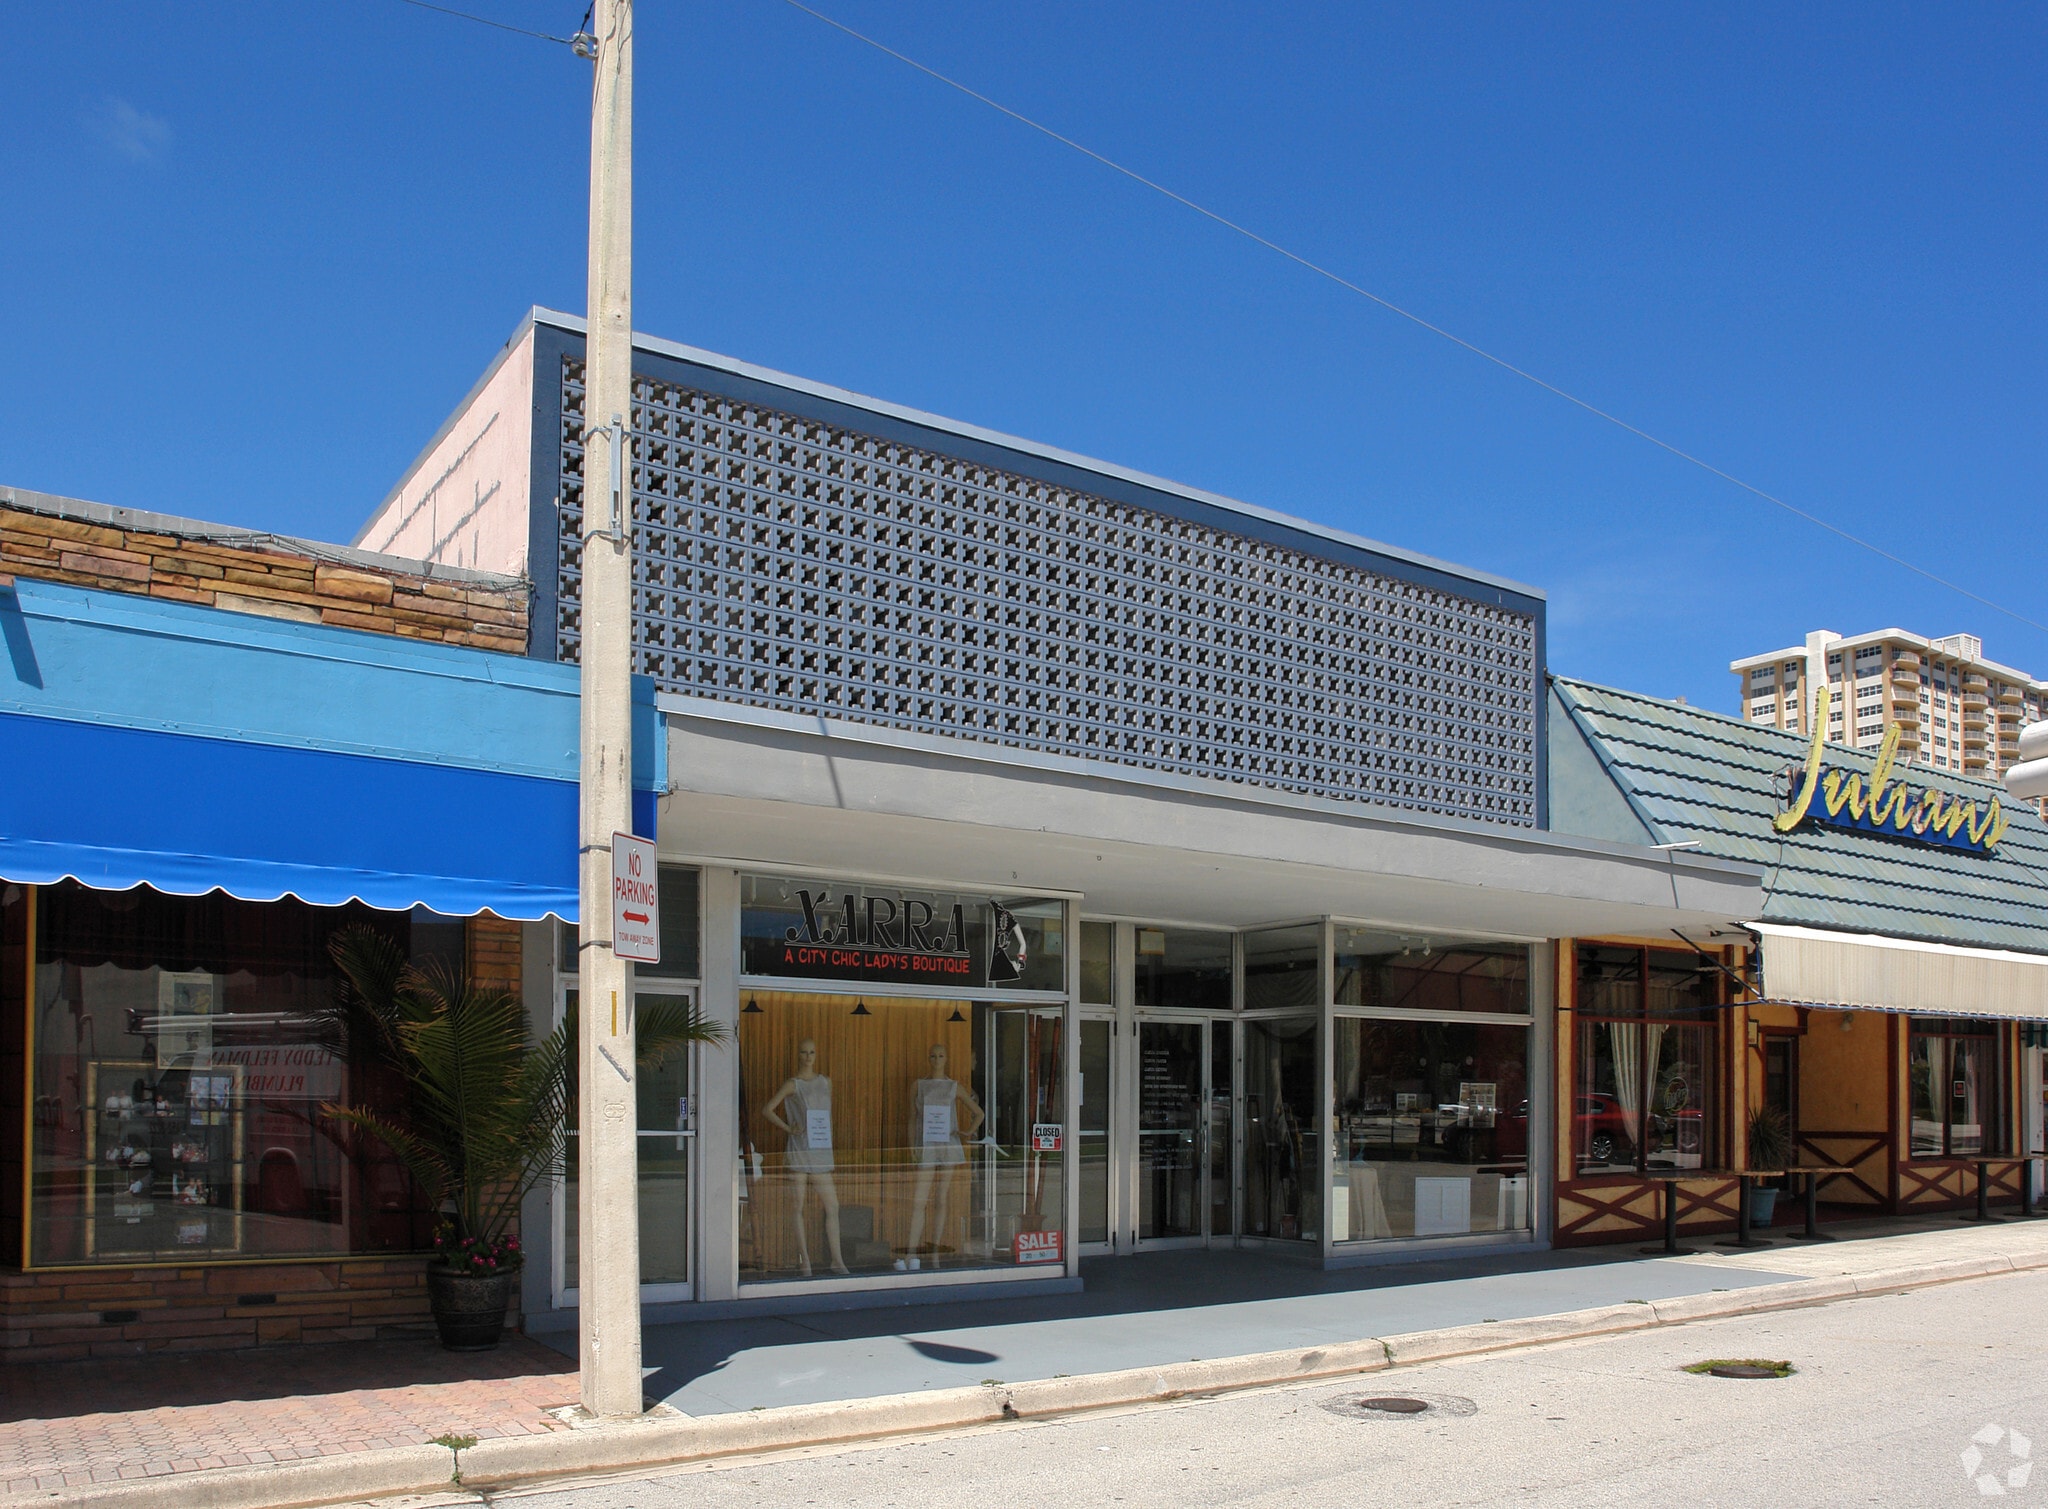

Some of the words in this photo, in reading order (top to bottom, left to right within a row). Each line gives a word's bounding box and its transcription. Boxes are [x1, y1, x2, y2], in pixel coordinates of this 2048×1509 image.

[628, 852, 641, 877] NO
[615, 877, 655, 906] PARKING
[785, 889, 969, 953] XARRA
[618, 931, 629, 942] TOW
[630, 934, 642, 943] AWAY
[642, 935, 654, 946] ZONE
[785, 949, 793, 964] A
[799, 949, 827, 965] CITY
[832, 951, 861, 967] CHIC
[864, 954, 908, 969] LADY'S
[912, 954, 970, 973] BOUTIQUE
[1035, 1127, 1060, 1137] CLOSED
[1018, 1232, 1058, 1250] SALE
